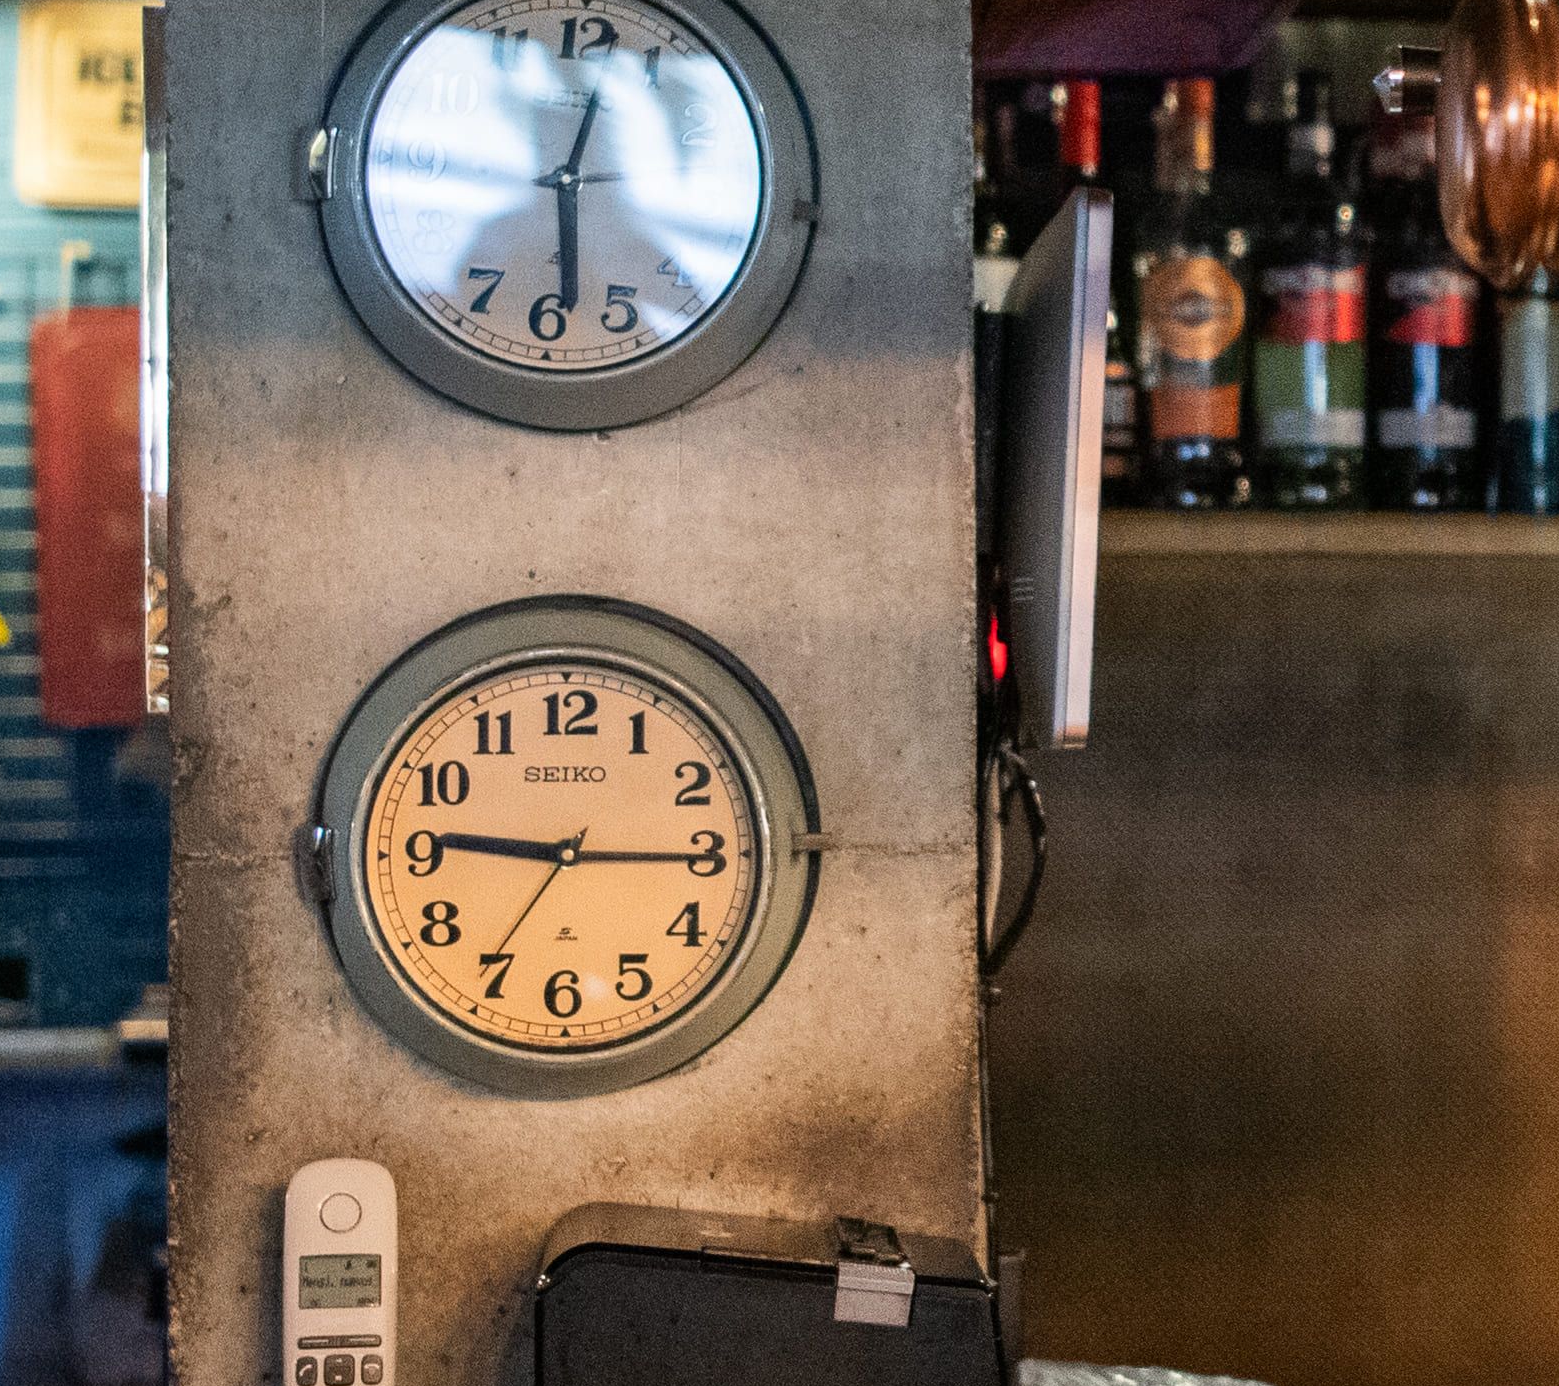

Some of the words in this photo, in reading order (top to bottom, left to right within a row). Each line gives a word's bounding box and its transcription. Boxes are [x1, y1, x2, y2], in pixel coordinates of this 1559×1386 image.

[490, 28, 530, 69] 11
[559, 16, 618, 60] 12
[643, 46, 660, 88] 1
[682, 103, 718, 146] 2
[407, 140, 447, 184] 9
[468, 268, 505, 315] 7
[657, 251, 692, 288] 4
[528, 293, 568, 341] 6
[600, 285, 638, 333] 5
[473, 711, 515, 755] 11
[543, 690, 598, 735] 12
[628, 711, 649, 754] 1
[417, 760, 470, 806] 10
[523, 765, 607, 783] SEIKO
[675, 761, 711, 806] 2
[405, 830, 444, 877] 9
[687, 830, 726, 877] 3
[419, 901, 462, 947] 8
[665, 902, 707, 947] 4
[479, 953, 515, 998] 7
[543, 970, 582, 1018] 6
[615, 953, 653, 1001] 5
